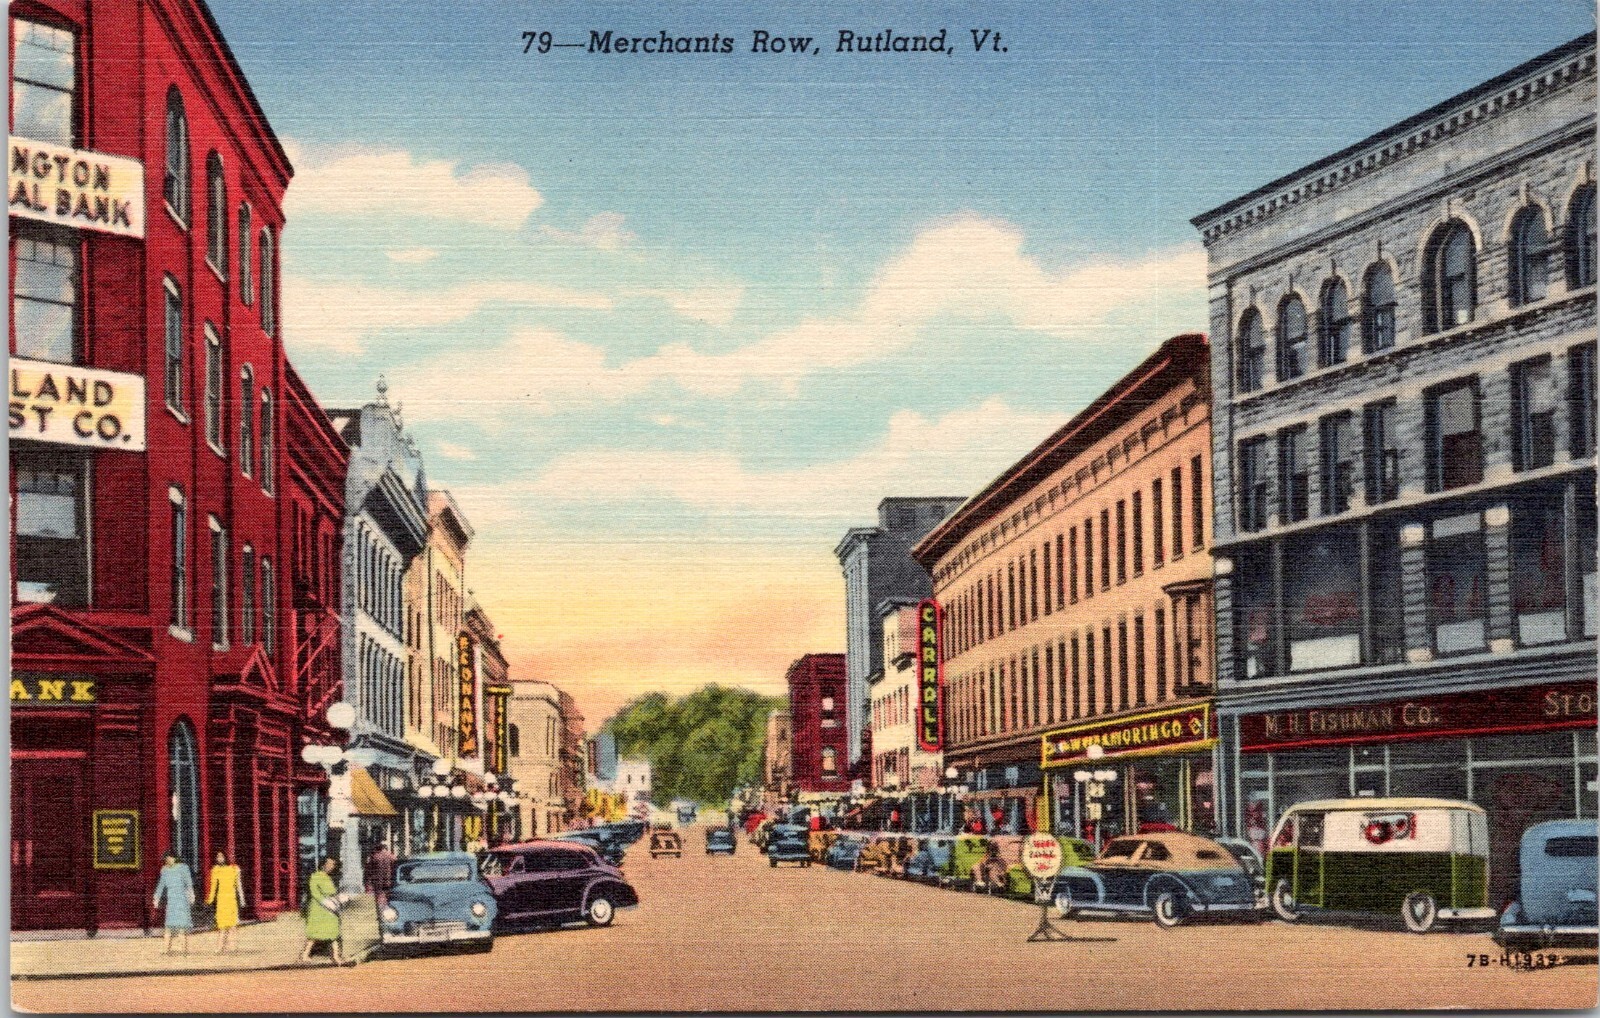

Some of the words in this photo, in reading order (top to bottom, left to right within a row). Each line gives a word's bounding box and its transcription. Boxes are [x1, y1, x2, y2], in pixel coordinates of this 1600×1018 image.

[11, 146, 111, 192] NGTON
[10, 180, 48, 213] AL
[55, 188, 132, 229] BANK
[12, 368, 115, 408] LAND
[9, 401, 54, 433] ST
[72, 409, 132, 443] CO.
[10, 680, 95, 701] ANK
